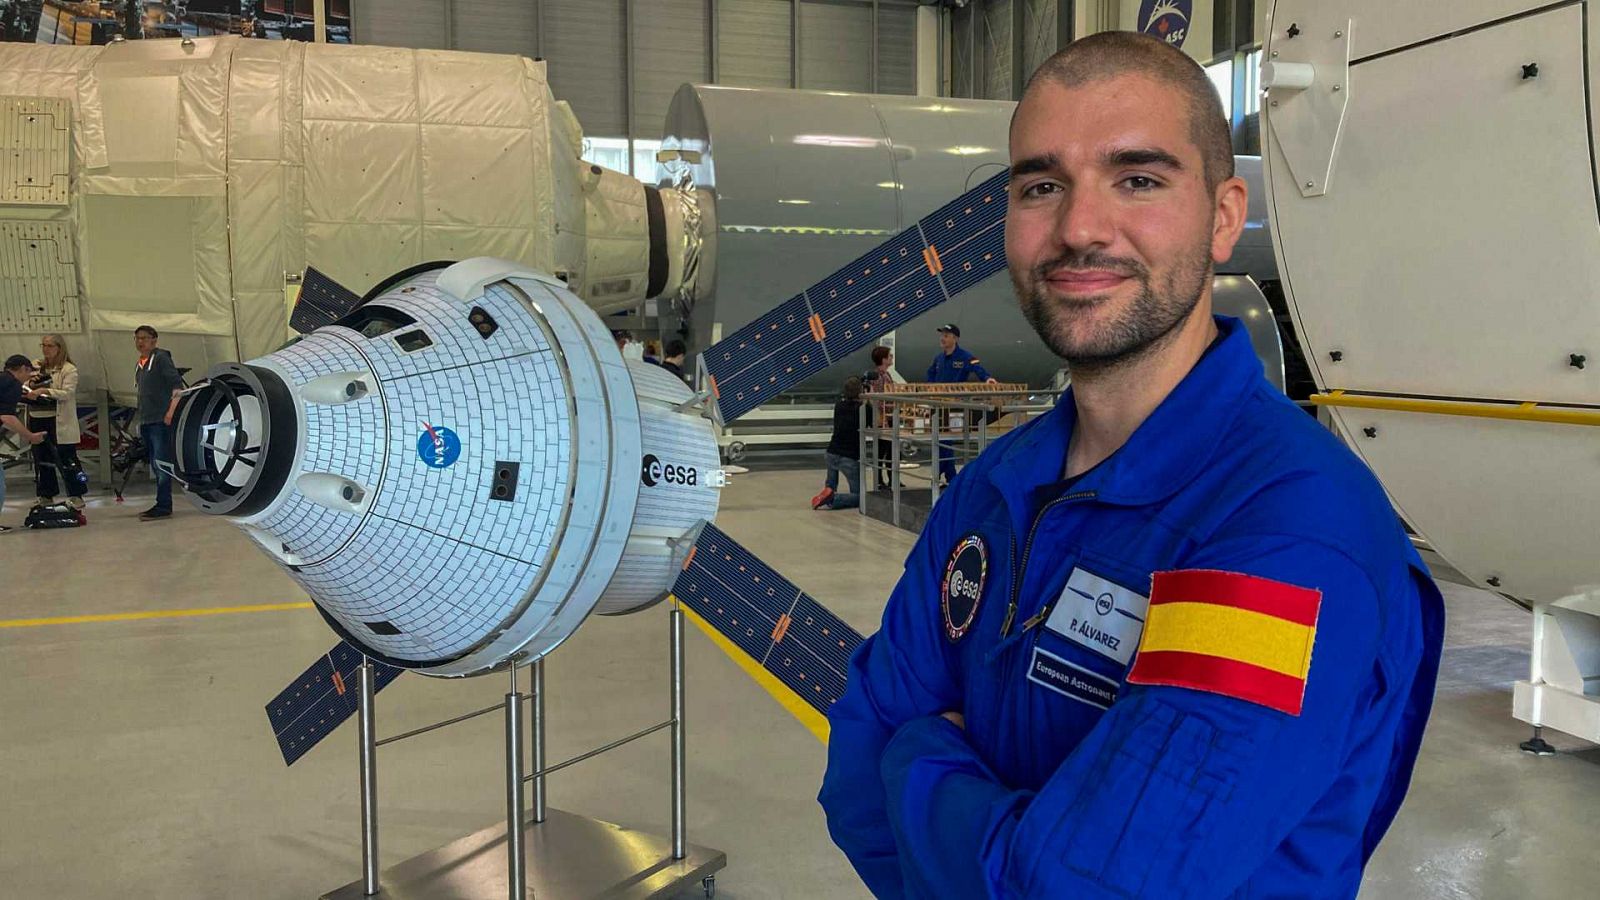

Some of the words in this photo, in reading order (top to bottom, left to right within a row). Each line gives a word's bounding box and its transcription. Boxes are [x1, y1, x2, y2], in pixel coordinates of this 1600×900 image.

[434, 429, 445, 465] NASA
[664, 464, 697, 486] esa
[963, 579, 979, 600] esa
[1070, 618, 1078, 632] P.
[1078, 620, 1121, 652] ÁLVAREZ
[1036, 661, 1070, 684] European
[1070, 676, 1112, 701] Astronaut
